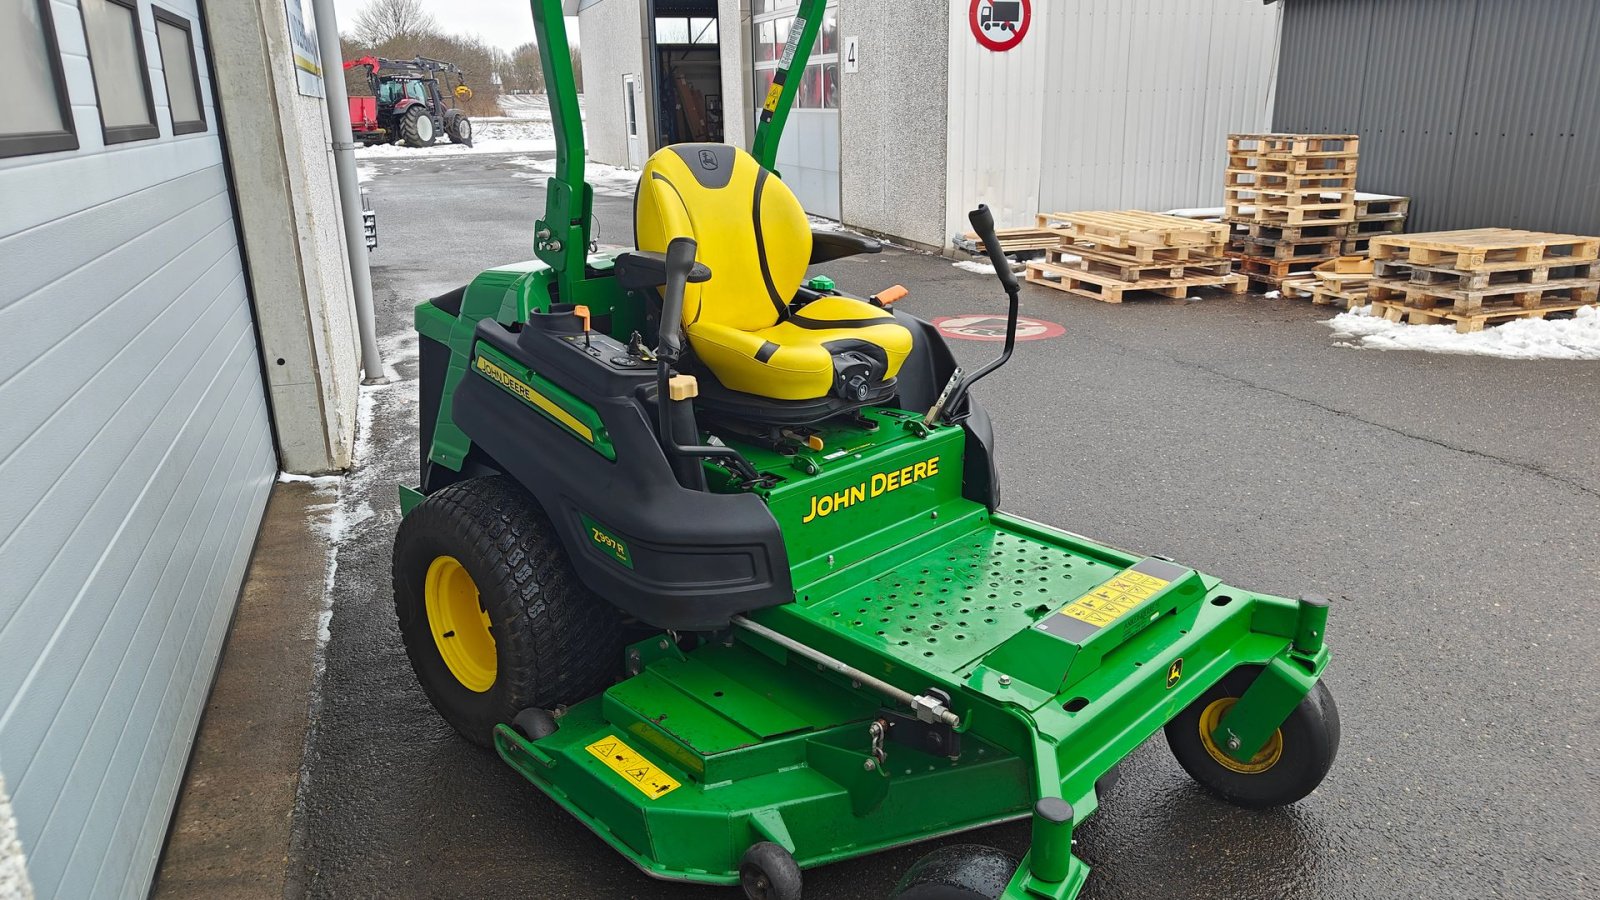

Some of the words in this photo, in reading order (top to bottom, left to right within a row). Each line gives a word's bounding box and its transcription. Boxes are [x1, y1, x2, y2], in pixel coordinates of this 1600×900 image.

[847, 41, 856, 68] 4
[481, 361, 503, 384] JOHN
[503, 373, 531, 400] DEERE
[803, 482, 866, 523] JOHN
[870, 456, 940, 498] DEERE
